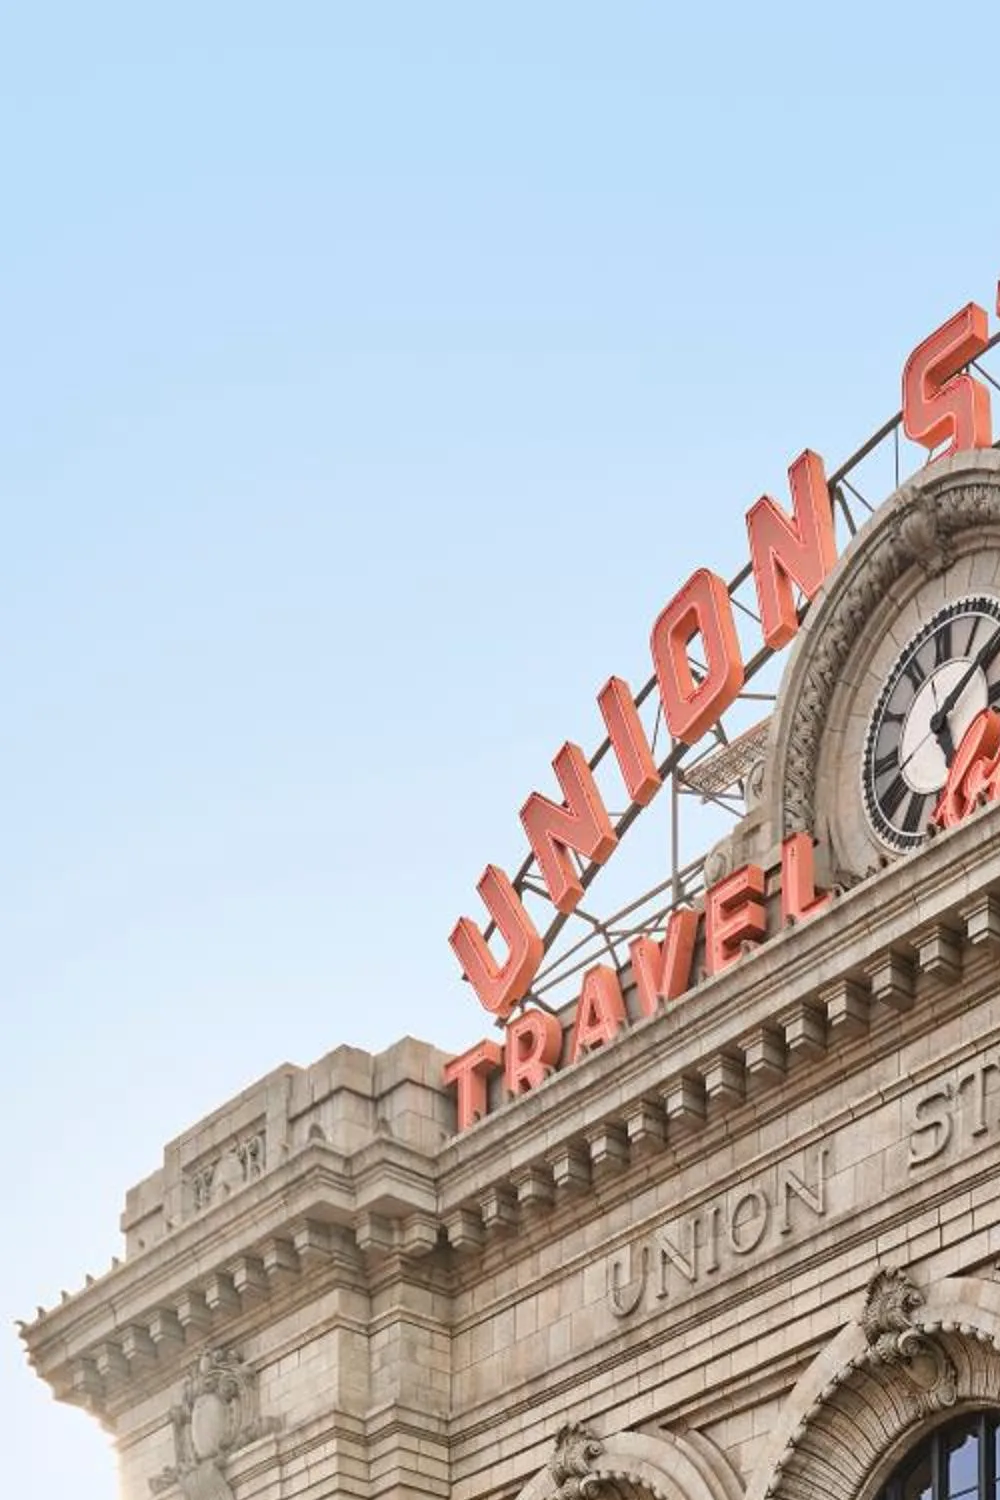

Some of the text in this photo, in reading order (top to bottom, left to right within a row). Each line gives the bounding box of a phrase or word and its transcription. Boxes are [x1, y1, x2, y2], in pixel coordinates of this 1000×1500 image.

[447, 448, 838, 1020] UNION
[444, 832, 834, 1133] TRAVEL
[605, 1146, 829, 1319] UNION
